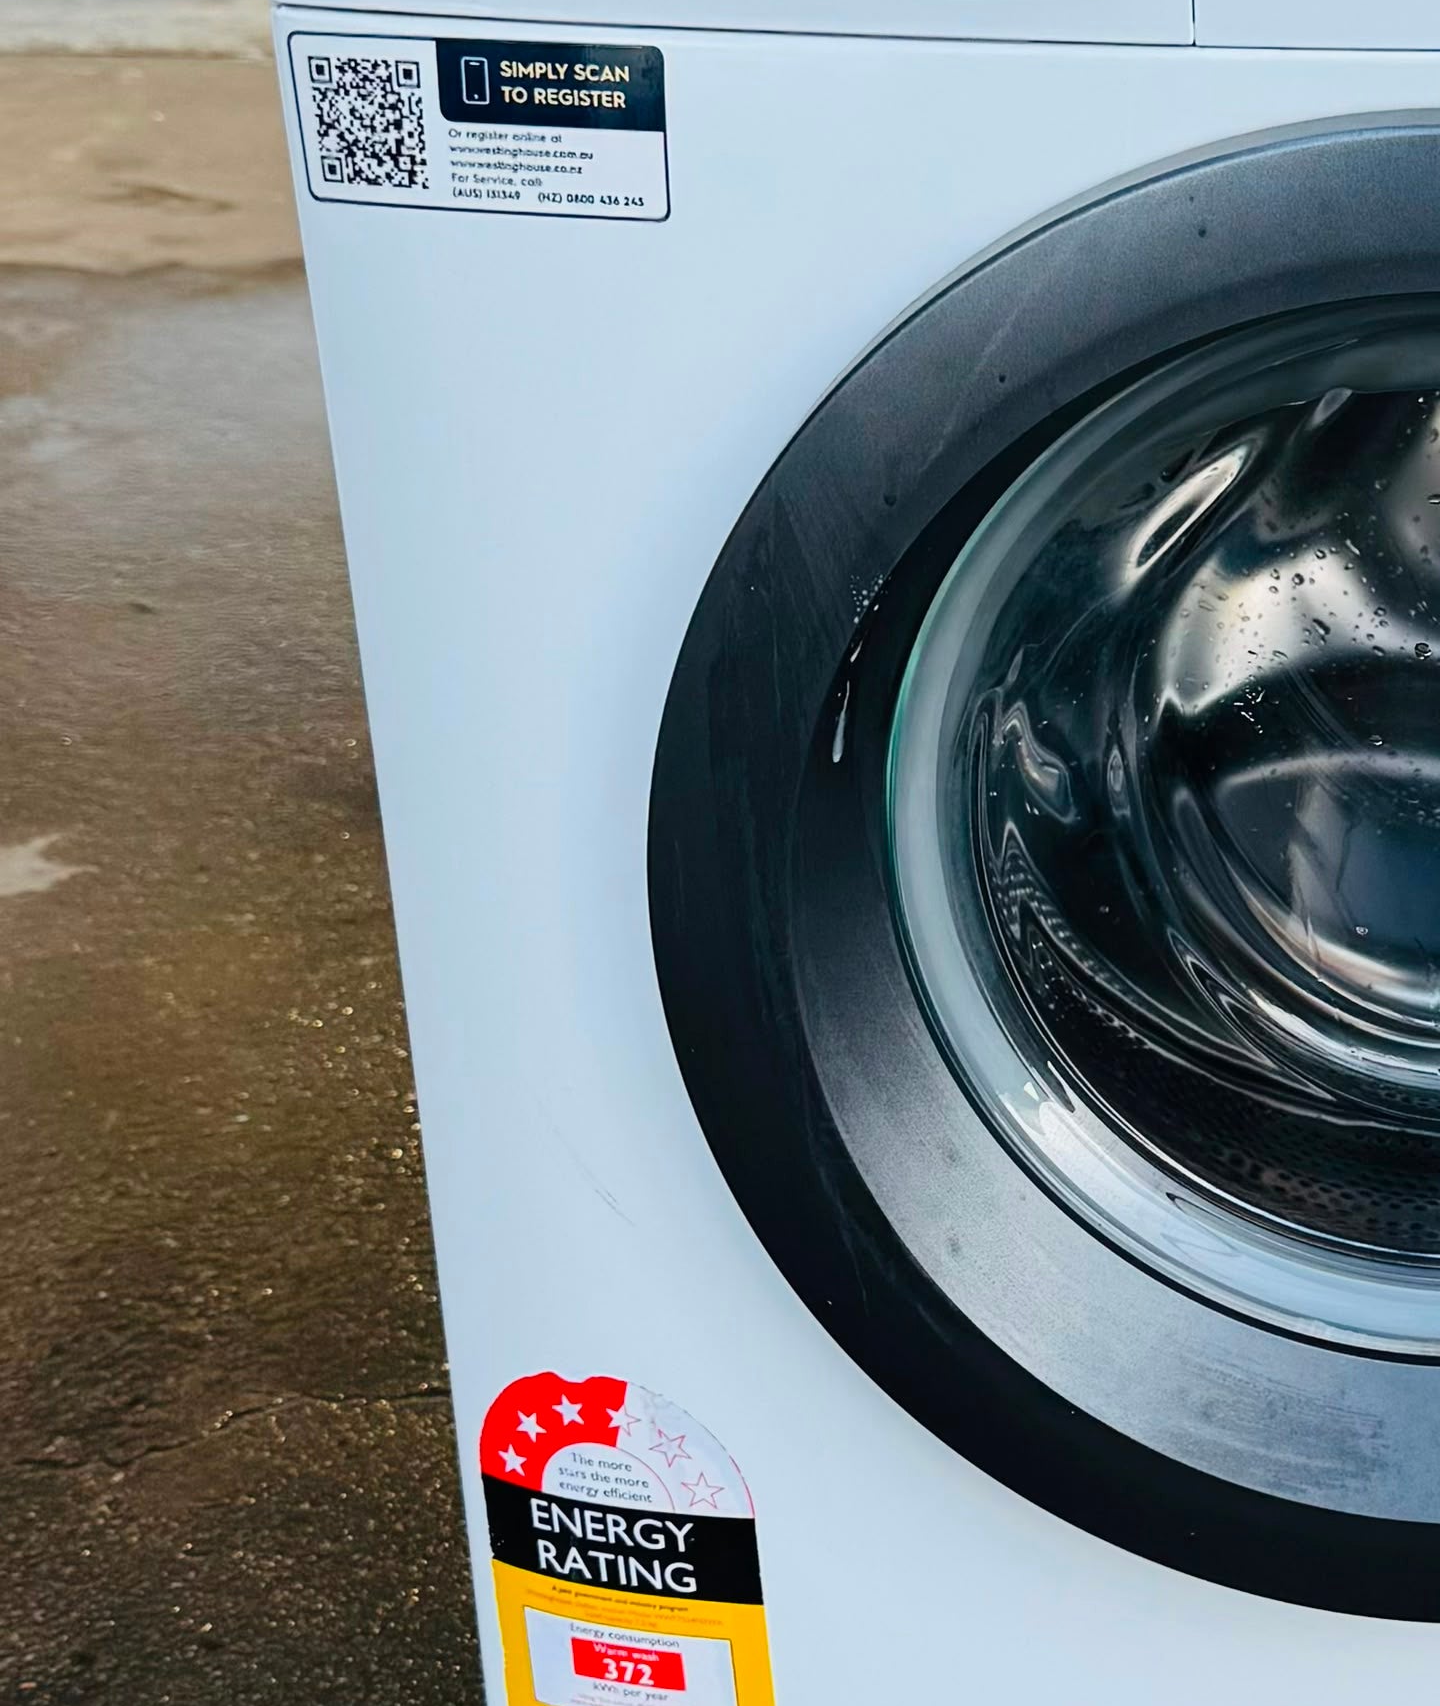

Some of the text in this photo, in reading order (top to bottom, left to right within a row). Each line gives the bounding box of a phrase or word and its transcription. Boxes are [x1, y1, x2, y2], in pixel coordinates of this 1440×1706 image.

[500, 59, 630, 83] SIMPLY SCAN
[501, 86, 627, 109] TO REGISTER
[448, 128, 562, 143] Or register online at
[451, 173, 469, 183] For
[453, 187, 482, 199] (AUS)
[538, 191, 562, 204] (NZ)
[566, 193, 595, 205] 0800
[571, 1452, 632, 1473] The more
[558, 1466, 649, 1488] stars the more
[559, 1481, 653, 1504] energy efficient
[530, 1497, 694, 1553] ENERGY
[537, 1539, 698, 1593] RATING
[570, 1622, 680, 1648] Energy consumption
[592, 1641, 660, 1662] Warm wash
[602, 1657, 655, 1686] 372
[623, 1688, 641, 1698] per
[645, 1691, 669, 1702] year
